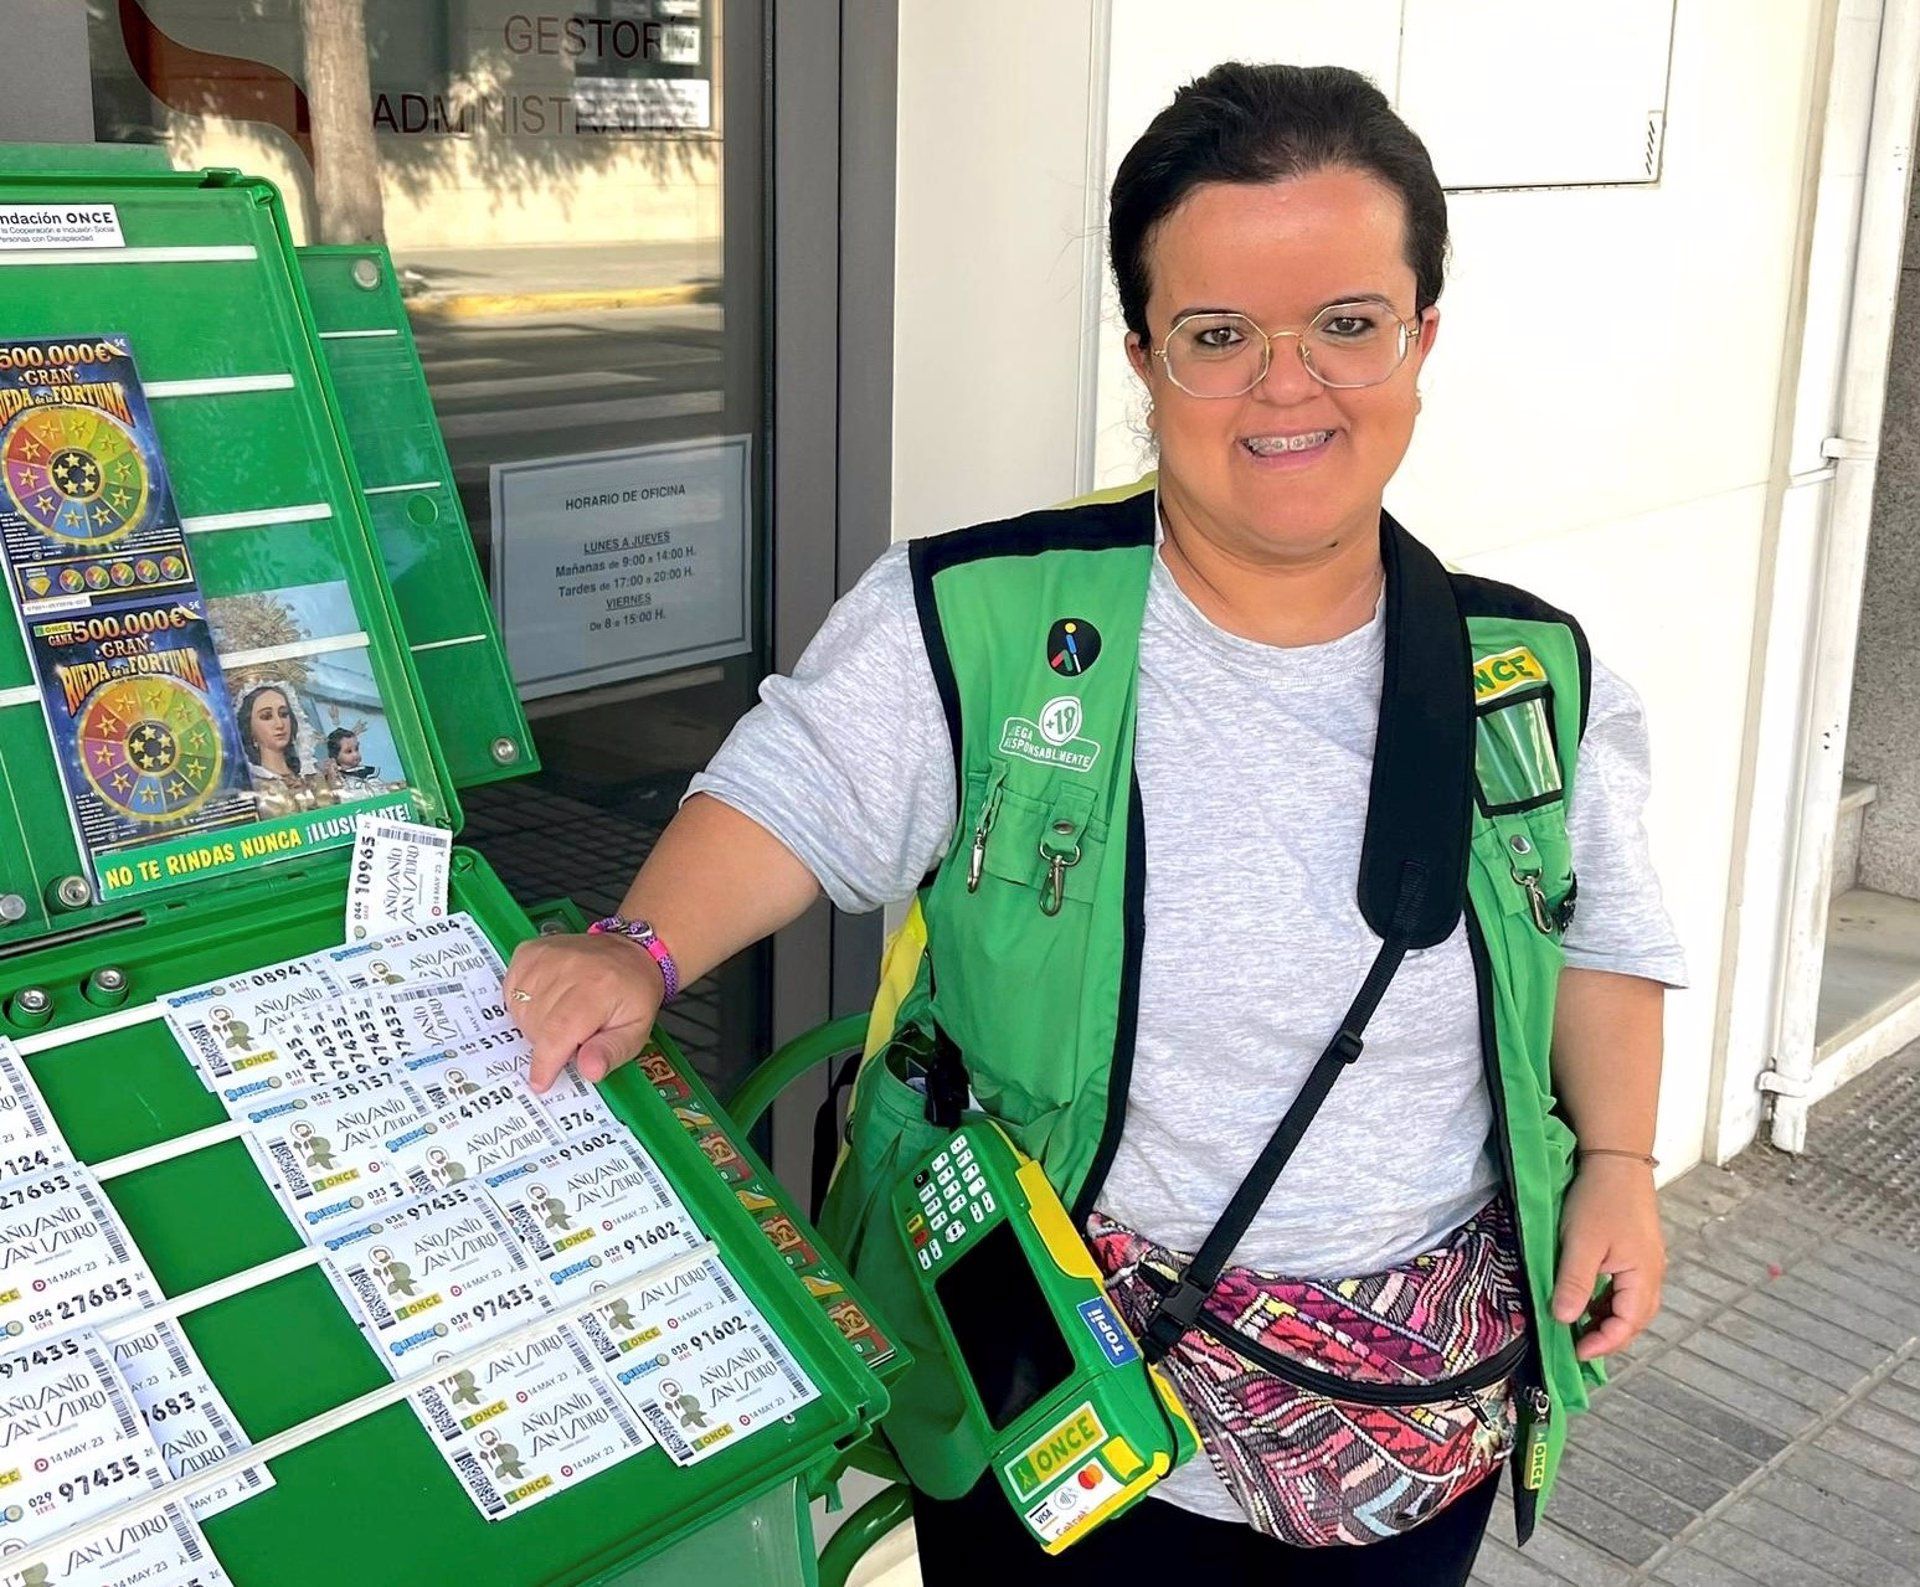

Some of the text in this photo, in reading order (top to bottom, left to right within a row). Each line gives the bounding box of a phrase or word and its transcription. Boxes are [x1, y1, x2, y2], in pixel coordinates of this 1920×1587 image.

[66, 212, 113, 224] ONCE
[24, 368, 74, 386] GRAN
[52, 381, 136, 428] FORTUNA
[565, 484, 686, 510] HORARIO DE OFICINA
[584, 531, 671, 554] LUNES A JUEVES
[555, 561, 606, 578] Mañanas
[608, 560, 620, 571] de
[622, 554, 646, 568] 9:00
[656, 547, 684, 563] 14:00
[686, 546, 697, 558] H.
[558, 581, 597, 598] Tardes
[599, 581, 612, 591] de
[614, 575, 644, 589] 17:00
[654, 569, 682, 584] 20:00
[684, 566, 695, 578] H.
[189, 601, 201, 610] 5€
[606, 593, 652, 611] VIERNES
[44, 607, 187, 643] ONCE 500.000€
[589, 620, 602, 631] De
[604, 618, 612, 630] 8
[623, 610, 653, 626] 15:00
[655, 608, 666, 621] H.
[99, 635, 150, 659] GRAN
[60, 660, 111, 719] RUEDA
[129, 648, 209, 694] FORTUNA
[1046, 706, 1076, 736] +18
[105, 867, 134, 890] NO
[138, 860, 162, 882] TE
[166, 843, 236, 876] RINDAS
[240, 828, 303, 860] NUNCA
[355, 835, 376, 894] 10965
[406, 918, 460, 942] 61084
[251, 961, 313, 987] 08941
[332, 1017, 371, 1074] 97435
[354, 1010, 394, 1066] 97435
[244, 1051, 277, 1067] ONCE
[333, 1072, 394, 1099] 38157
[459, 1085, 514, 1119] 41930
[559, 1131, 617, 1161] 91602
[326, 1168, 360, 1187] ONCE
[406, 1189, 469, 1220] 97435
[565, 1227, 595, 1246] ONCE
[603, 1220, 680, 1258] 029 91602
[85, 1260, 98, 1272] 23
[29, 1308, 53, 1324] 054
[57, 1276, 133, 1320] 27683
[408, 1294, 441, 1314] ONCE
[472, 1283, 534, 1322] 97435
[630, 1326, 661, 1346] ONCE
[690, 1315, 748, 1351] 91602
[0, 1338, 79, 1379] 97435
[474, 1400, 507, 1424] ONCE
[703, 1423, 734, 1444] ONCE
[1036, 1415, 1096, 1472] ONCE
[50, 1436, 105, 1464] 14 23
[1532, 1445, 1545, 1486] ONCE
[28, 1455, 141, 1508] 029 97435
[215, 1487, 228, 1499] 23
[517, 1475, 552, 1498] ONCE
[1035, 1508, 1053, 1525] VISA
[155, 1560, 169, 1573] 23
